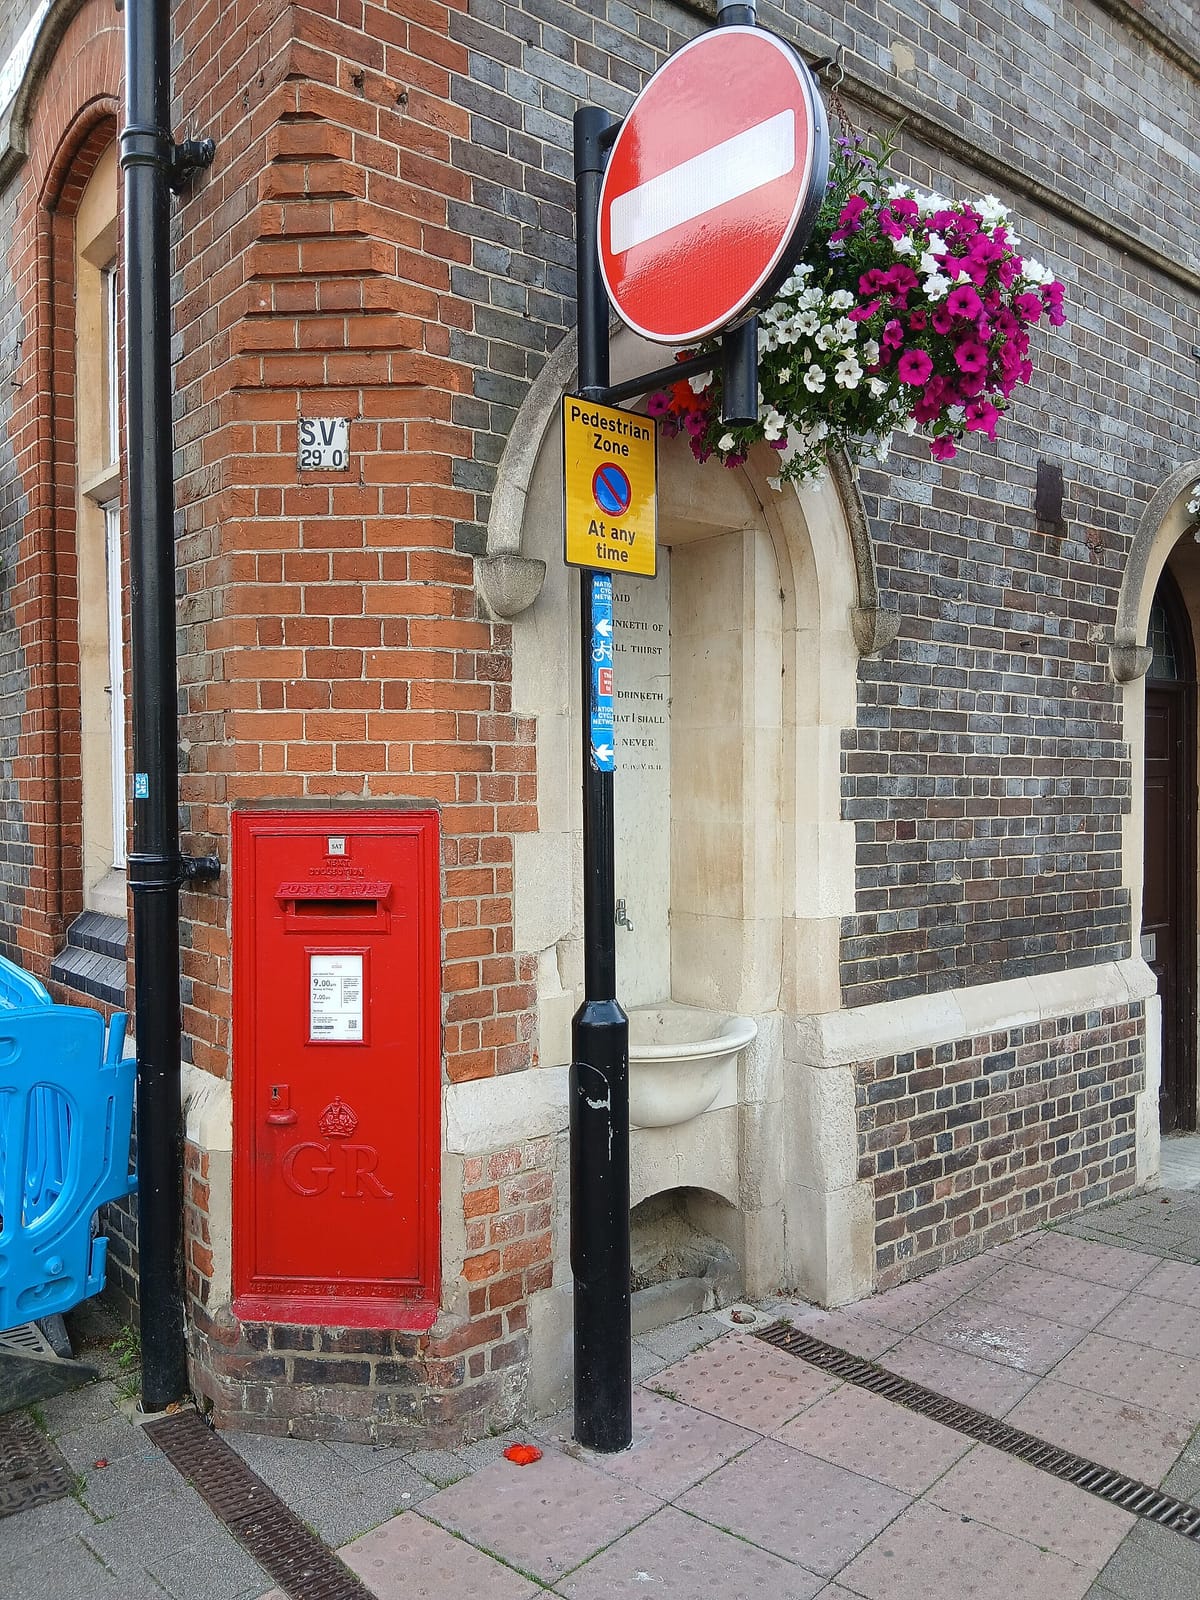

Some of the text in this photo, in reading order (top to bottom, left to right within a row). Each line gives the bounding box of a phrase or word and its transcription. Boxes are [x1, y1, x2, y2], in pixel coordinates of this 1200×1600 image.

[571, 406, 650, 441] Pedestrian
[593, 433, 629, 457] Zone
[588, 520, 636, 546] At any
[596, 543, 629, 562] time
[652, 623, 663, 632] OF
[631, 644, 662, 655] THIRST
[617, 690, 663, 701] DRINKETH
[638, 715, 664, 724] SHALL
[622, 738, 654, 747] NEVER
